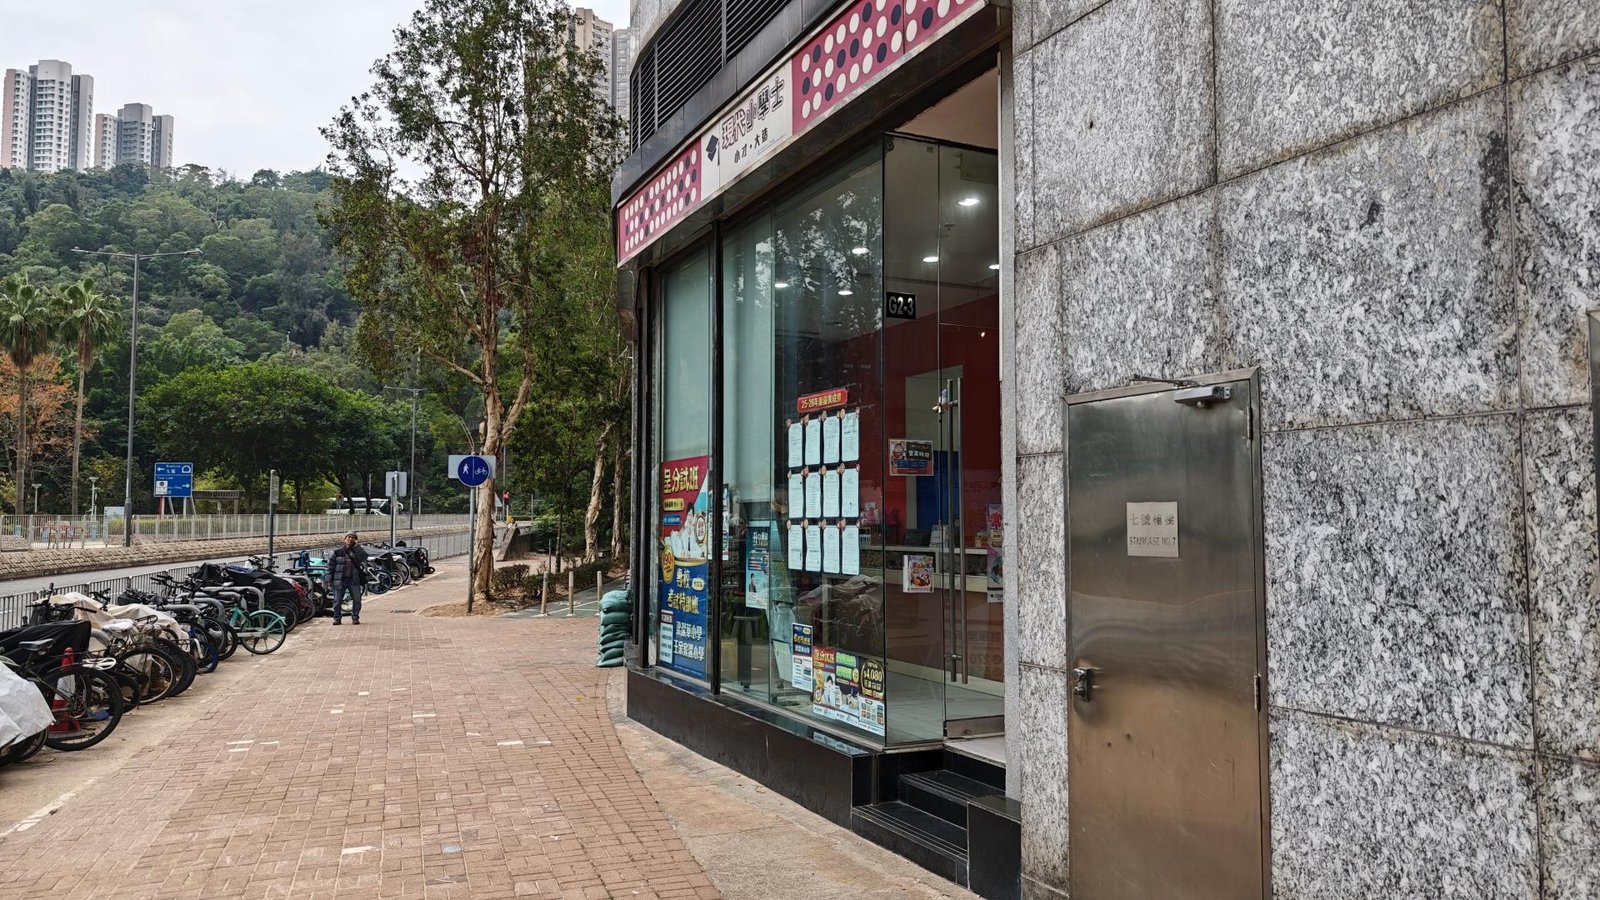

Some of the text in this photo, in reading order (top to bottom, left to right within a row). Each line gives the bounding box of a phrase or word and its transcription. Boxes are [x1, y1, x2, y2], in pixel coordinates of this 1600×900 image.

[722, 76, 784, 150] 現代小學士
[889, 296, 914, 315] G2-3
[664, 466, 699, 493] 呈分試班
[1129, 536, 1160, 545] STAIRCASE
